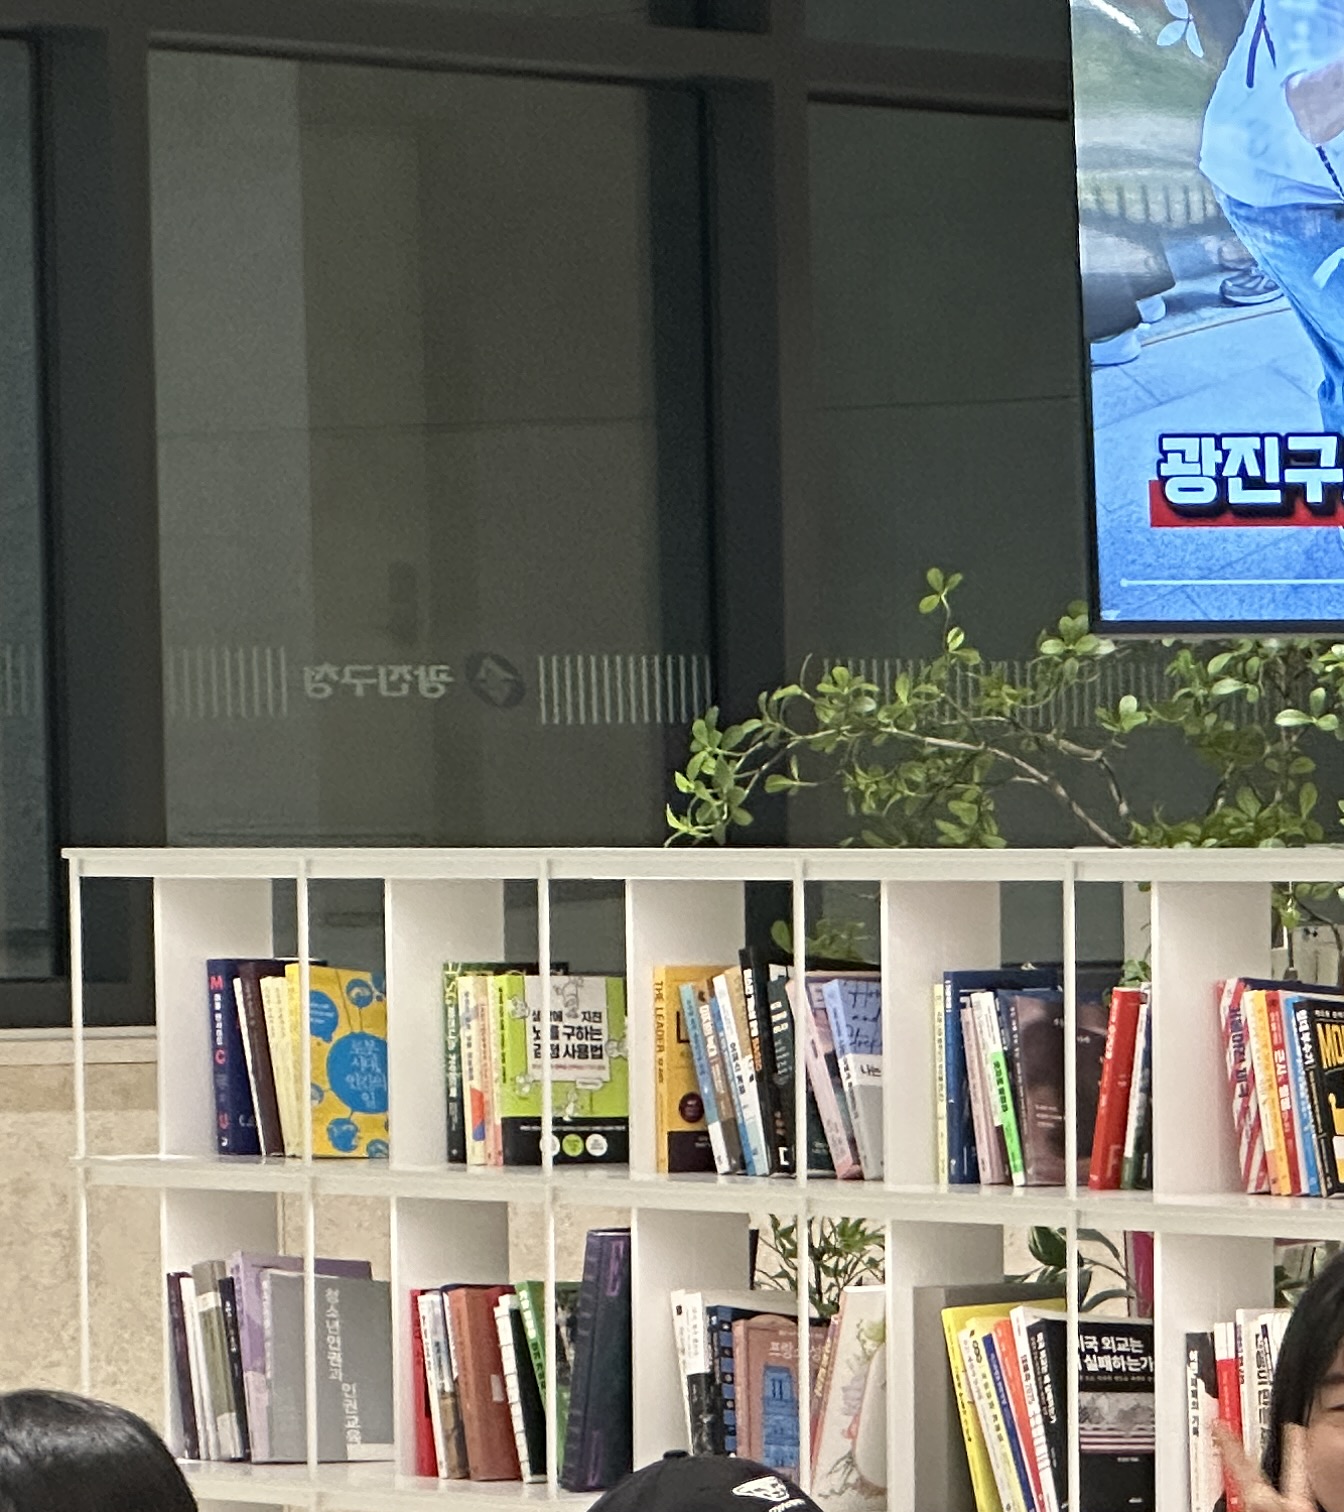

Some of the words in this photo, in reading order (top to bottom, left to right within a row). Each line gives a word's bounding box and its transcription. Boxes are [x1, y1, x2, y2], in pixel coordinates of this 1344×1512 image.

[655, 981, 664, 1003] THE
[562, 1025, 602, 1041] 구하는
[656, 1007, 664, 1053] LEADER
[563, 1043, 603, 1059] 사용법
[1101, 1335, 1143, 1353] 외교는
[1084, 1354, 1153, 1372] 실패하는가
